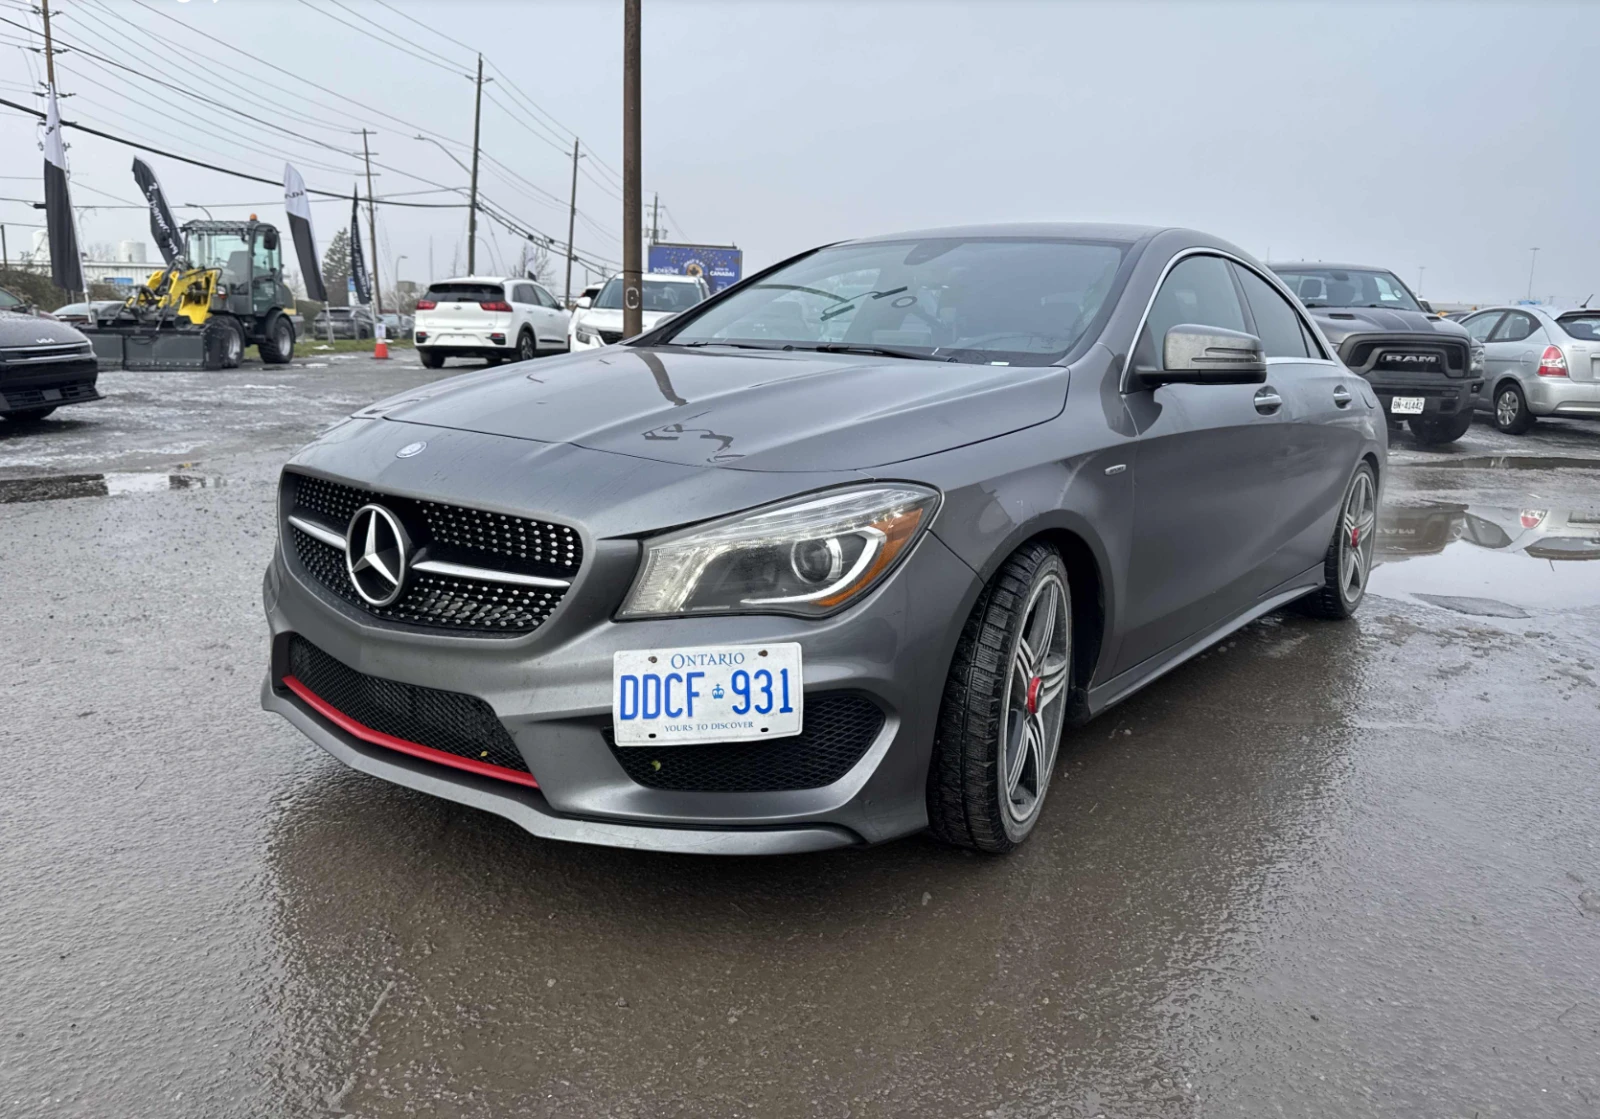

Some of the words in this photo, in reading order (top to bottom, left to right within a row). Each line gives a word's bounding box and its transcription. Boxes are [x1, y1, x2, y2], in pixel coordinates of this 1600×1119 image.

[671, 652, 745, 669] ONTARIO
[620, 671, 705, 720] DDCF
[731, 668, 793, 715] 931
[664, 723, 693, 732] YOURS
[697, 723, 708, 731] TO
[711, 721, 754, 730] DISCOVER
